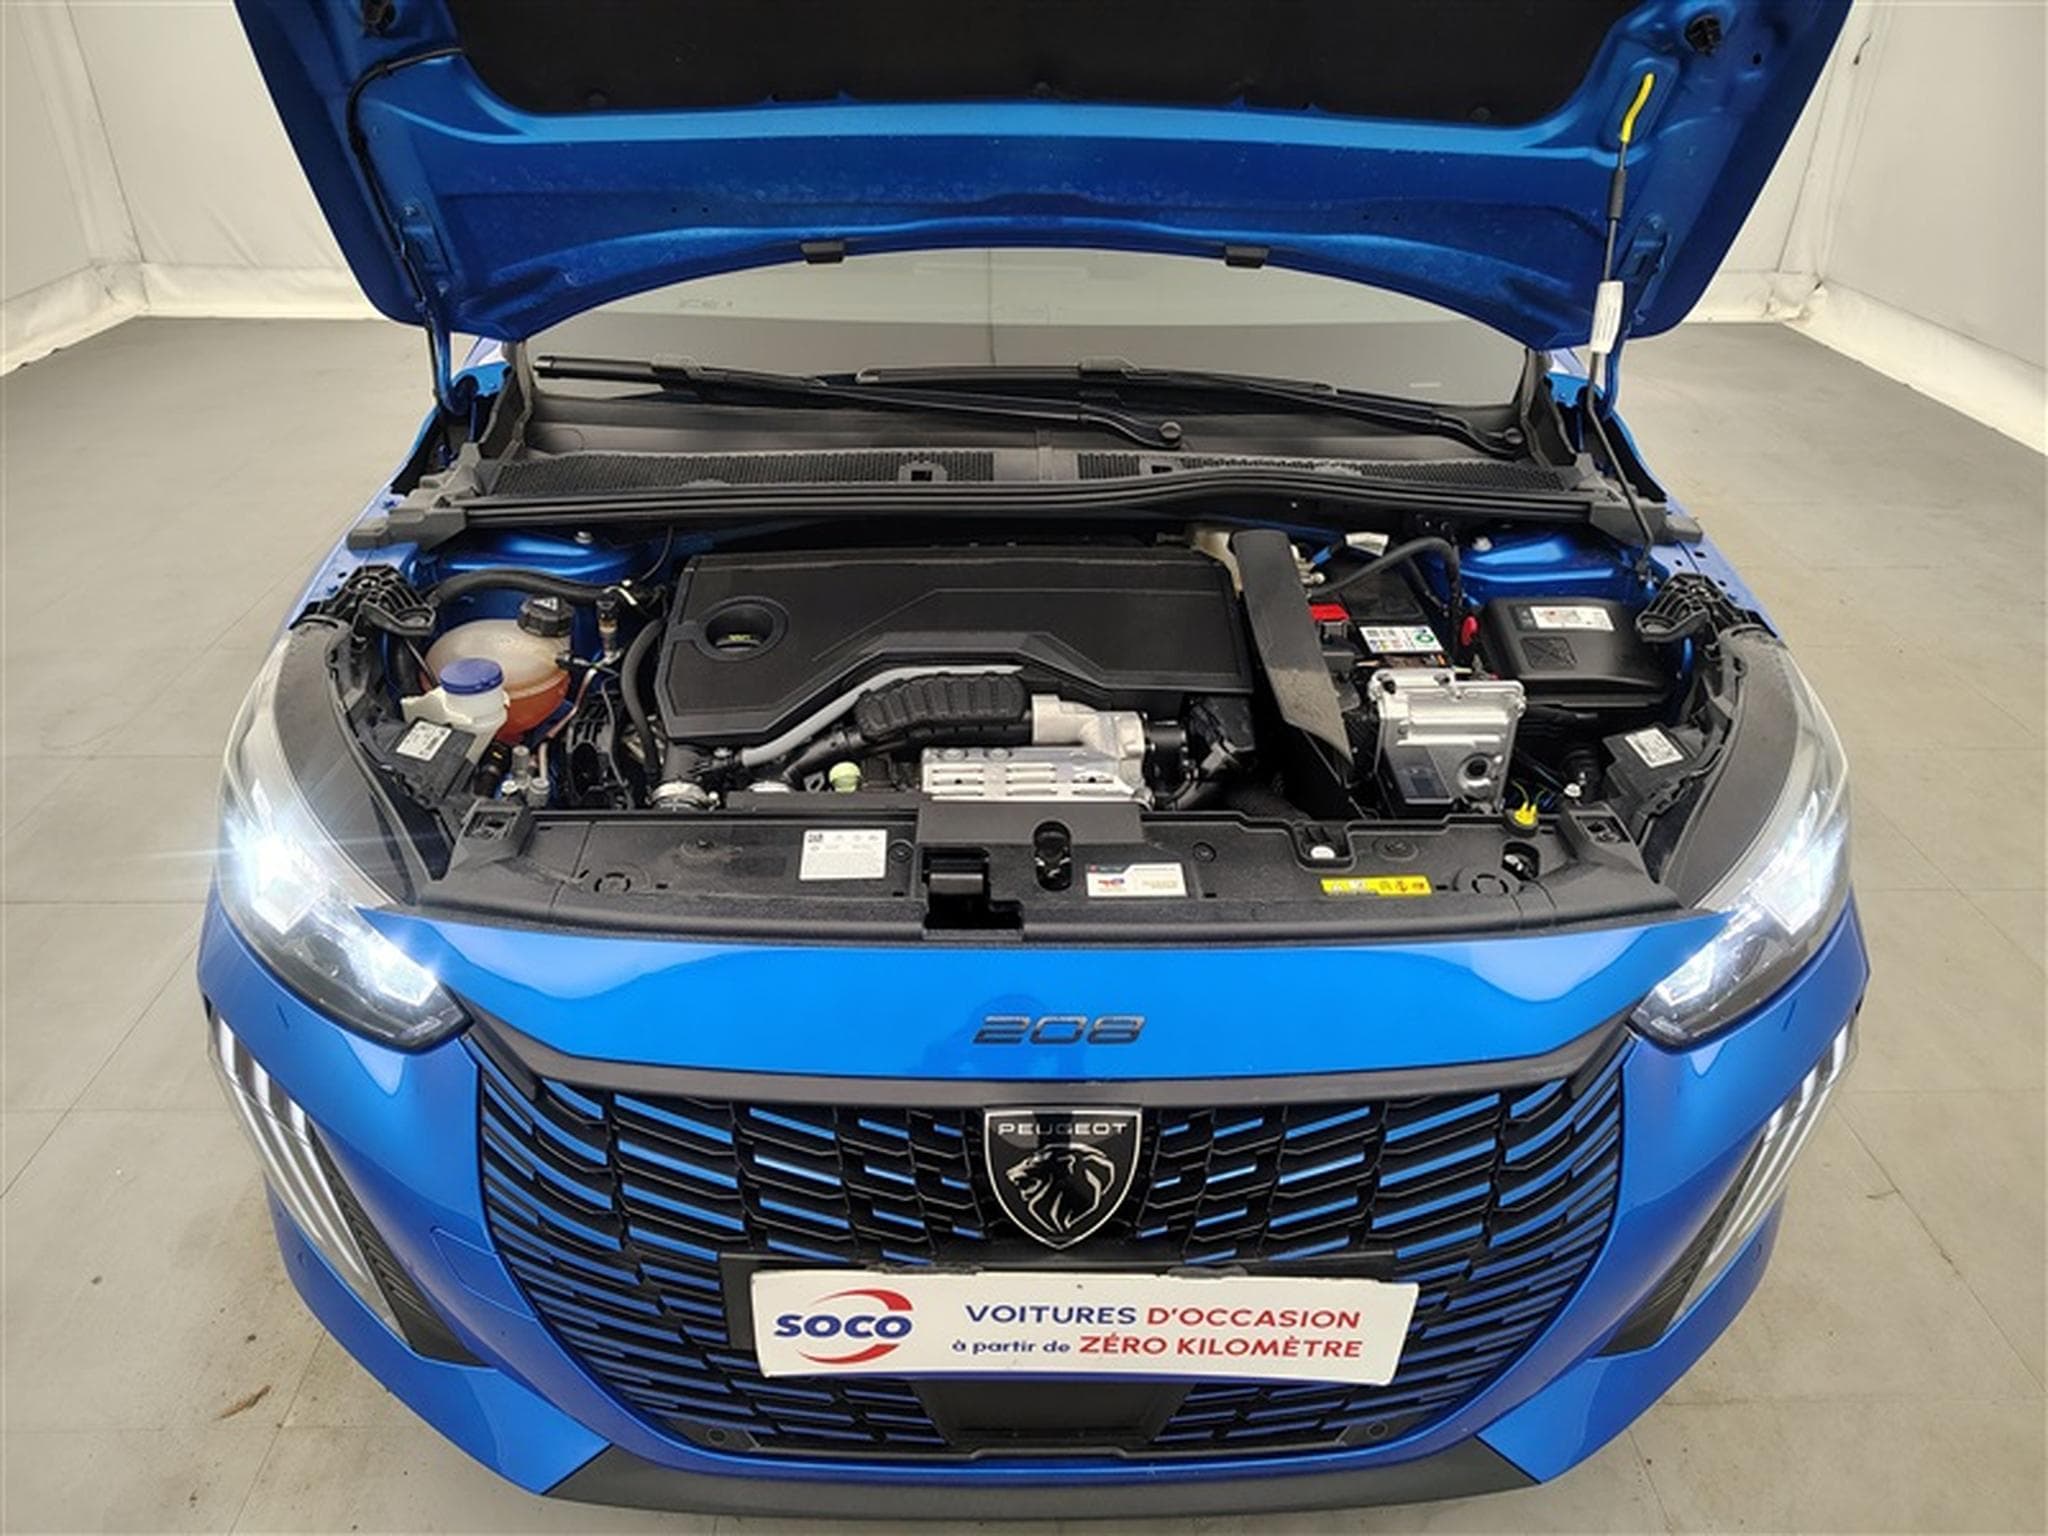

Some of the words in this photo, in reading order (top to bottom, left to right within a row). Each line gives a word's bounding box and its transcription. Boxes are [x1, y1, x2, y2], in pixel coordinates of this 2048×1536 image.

[972, 1014, 1146, 1044] 208
[997, 1122, 1128, 1136] PEUGEOT
[773, 1314, 913, 1339] SOCO
[965, 1304, 1137, 1325] VOITURES
[1146, 1307, 1361, 1329] D'OCCASION
[952, 1340, 967, 1353] à
[972, 1340, 1036, 1355] partir
[1042, 1340, 1071, 1353] de
[1078, 1331, 1168, 1355] ZÉRO
[1176, 1335, 1363, 1358] KILOMÈTRE
